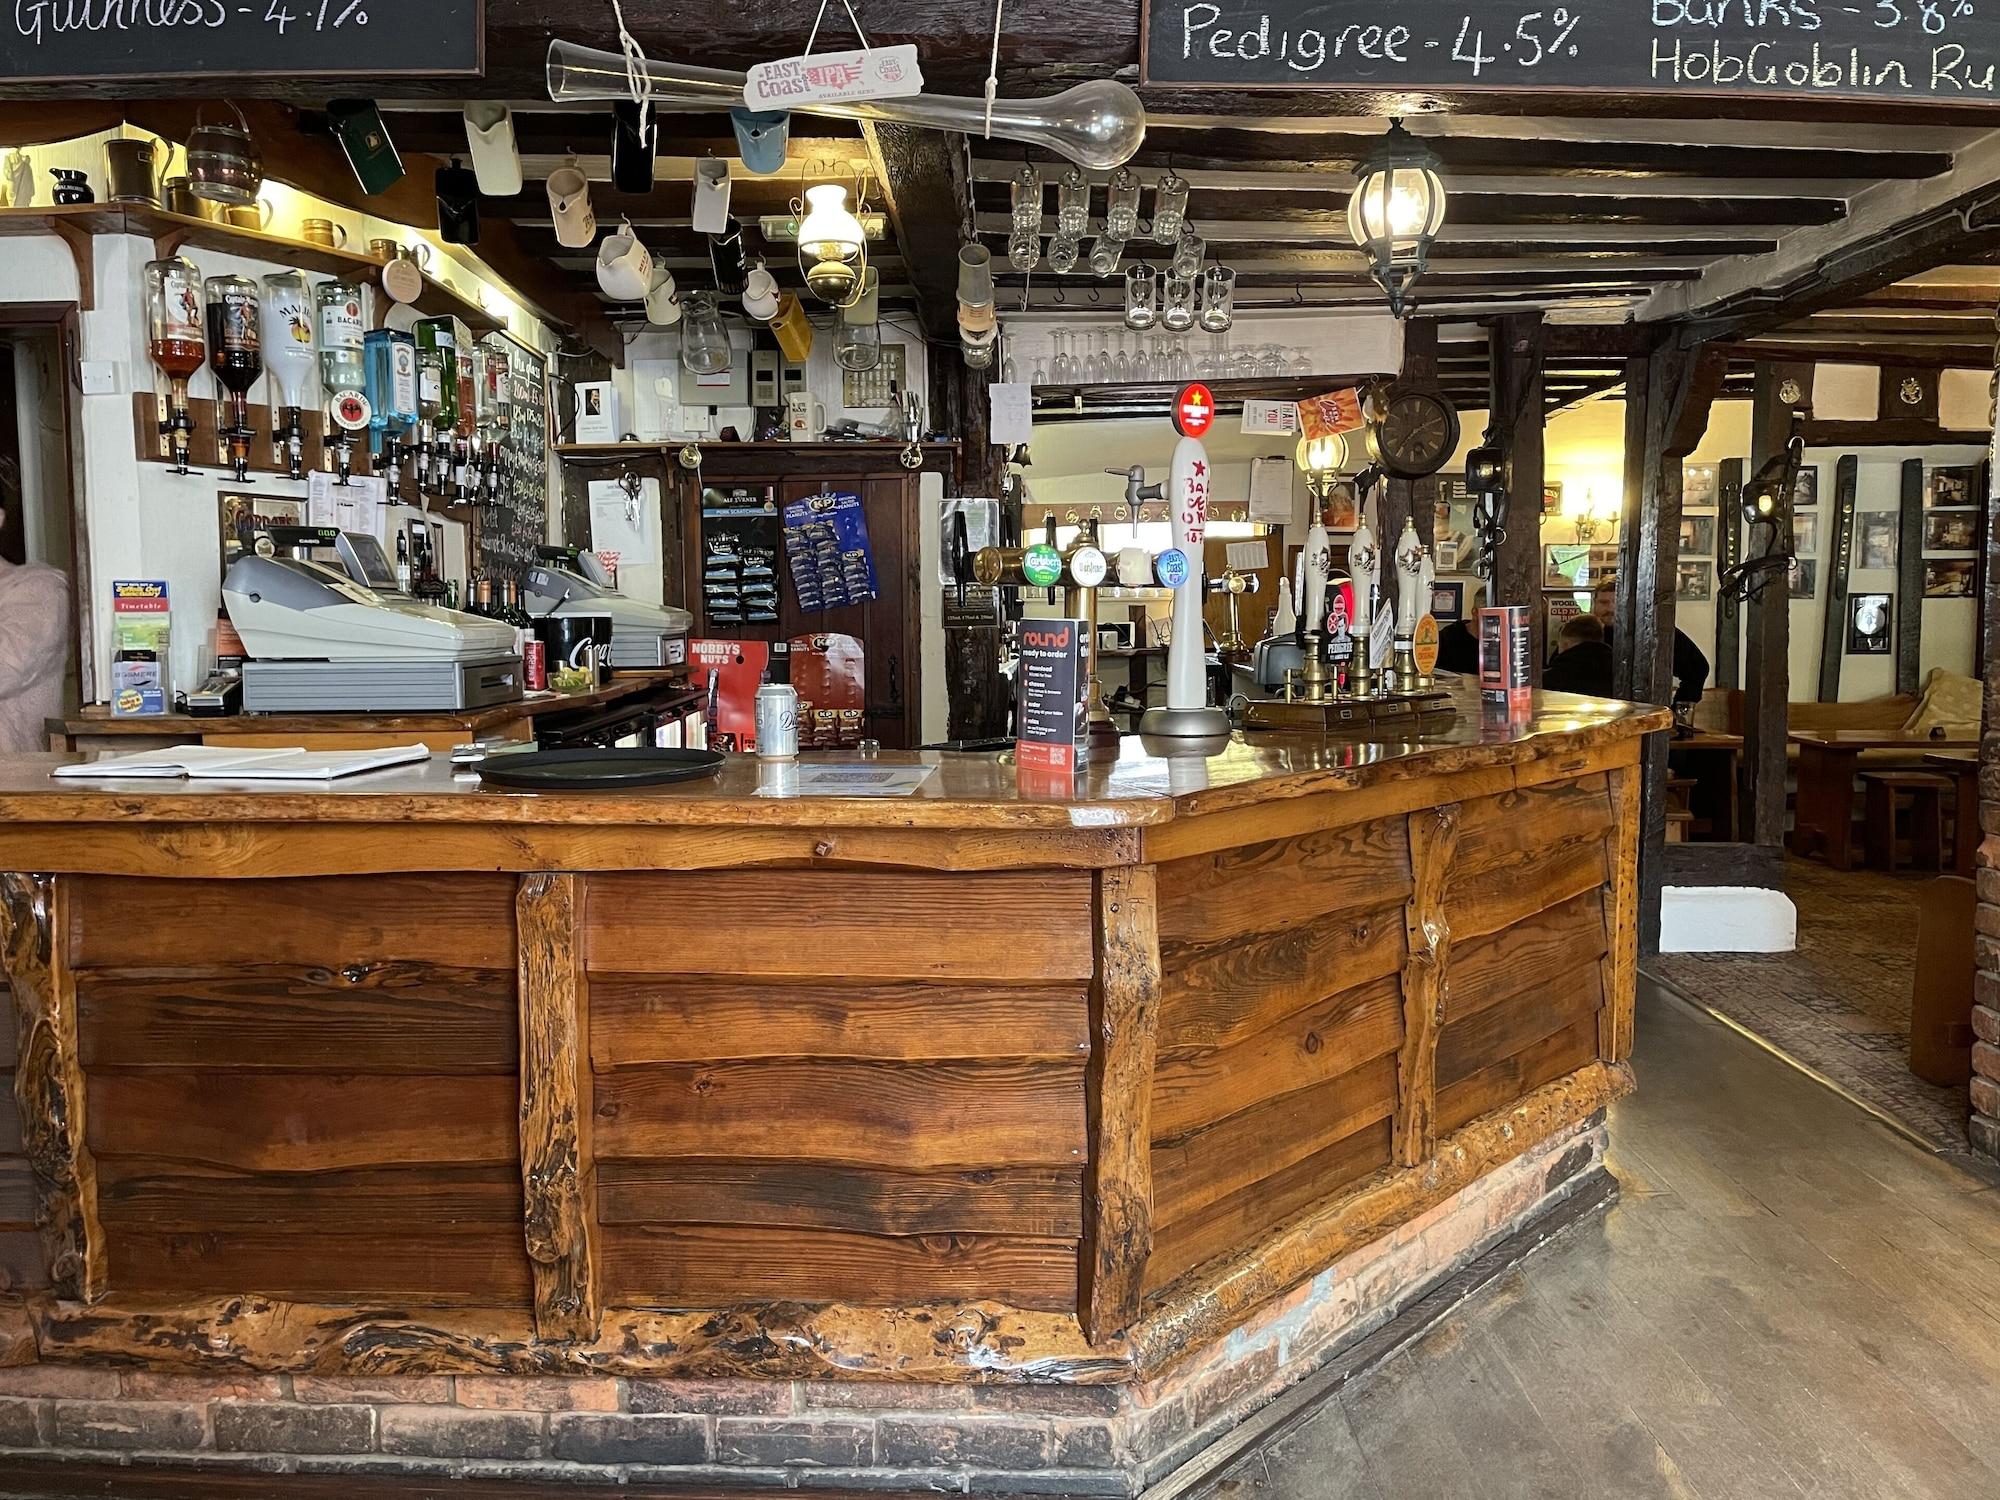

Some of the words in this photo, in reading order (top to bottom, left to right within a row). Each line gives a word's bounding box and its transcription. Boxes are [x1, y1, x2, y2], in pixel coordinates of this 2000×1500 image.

[1182, 3, 1410, 70] Pedigree
[1452, 8, 1580, 76] 4.5%
[1651, 38, 1912, 86] HobGoblin
[764, 61, 800, 80] EAST
[817, 65, 848, 85] IPA
[757, 74, 811, 98] Coast
[1268, 409, 1277, 423] YOU
[1281, 403, 1293, 430] THANK
[813, 499, 832, 509] KP
[817, 639, 835, 647] KP
[1023, 626, 1069, 647] round
[692, 642, 740, 655] NOBBY'S
[1047, 650, 1067, 658] order
[701, 654, 729, 664] NUTS
